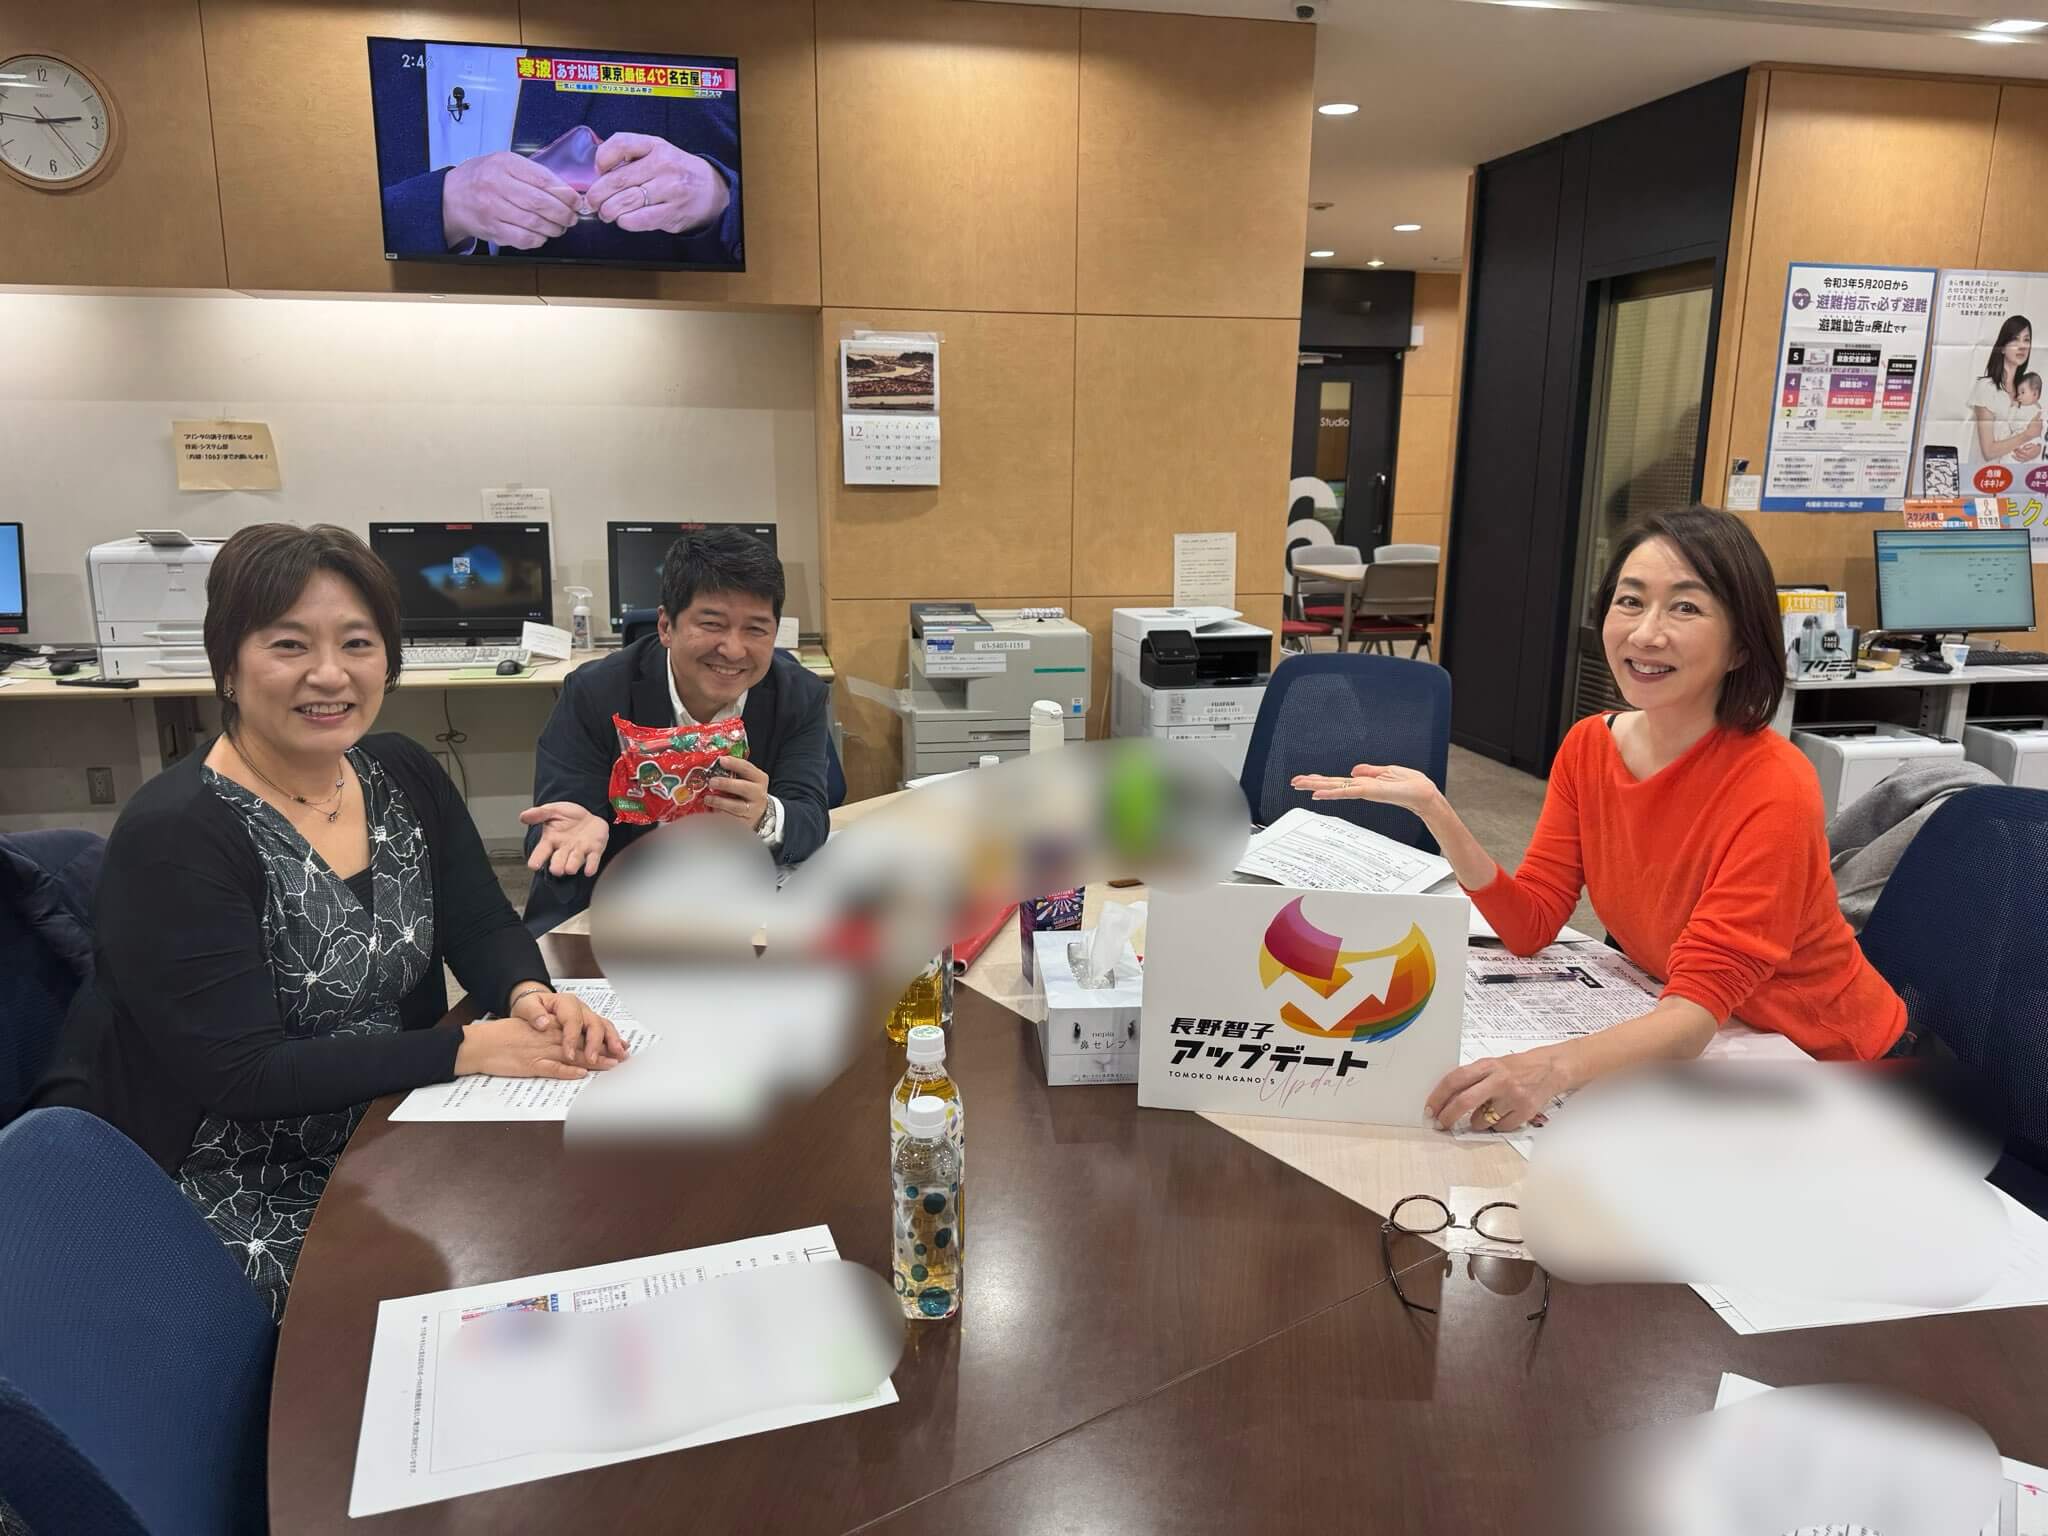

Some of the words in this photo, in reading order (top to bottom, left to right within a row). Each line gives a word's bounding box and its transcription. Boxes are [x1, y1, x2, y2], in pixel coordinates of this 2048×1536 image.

[37, 67, 48, 82] 12
[518, 58, 552, 79] 寒波
[91, 115, 99, 130] 3
[49, 159, 58, 173] 6
[1823, 277, 1909, 290] 令和3年5月20日から
[1798, 299, 1804, 307] 4
[1816, 293, 1928, 313] 避難指示で必ず避難
[1818, 318, 1907, 334] 避難勧告は廃止です
[1793, 352, 1799, 361] 5
[1789, 378, 1796, 386] 4
[1787, 394, 1793, 403] 3
[1786, 409, 1792, 417] 2
[1320, 416, 1350, 428] Studio
[1786, 421, 1790, 429] 1
[850, 425, 864, 437] 12
[1169, 1016, 1276, 1040] 長野智子
[1091, 1031, 1115, 1040] nepia
[1079, 1039, 1128, 1050] 鼻セレブ
[1169, 1039, 1369, 1078] アップデート
[1168, 1070, 1213, 1081] TOMOKO
[1217, 1073, 1276, 1086] NAGANO'S
[1258, 1060, 1361, 1110] Update
